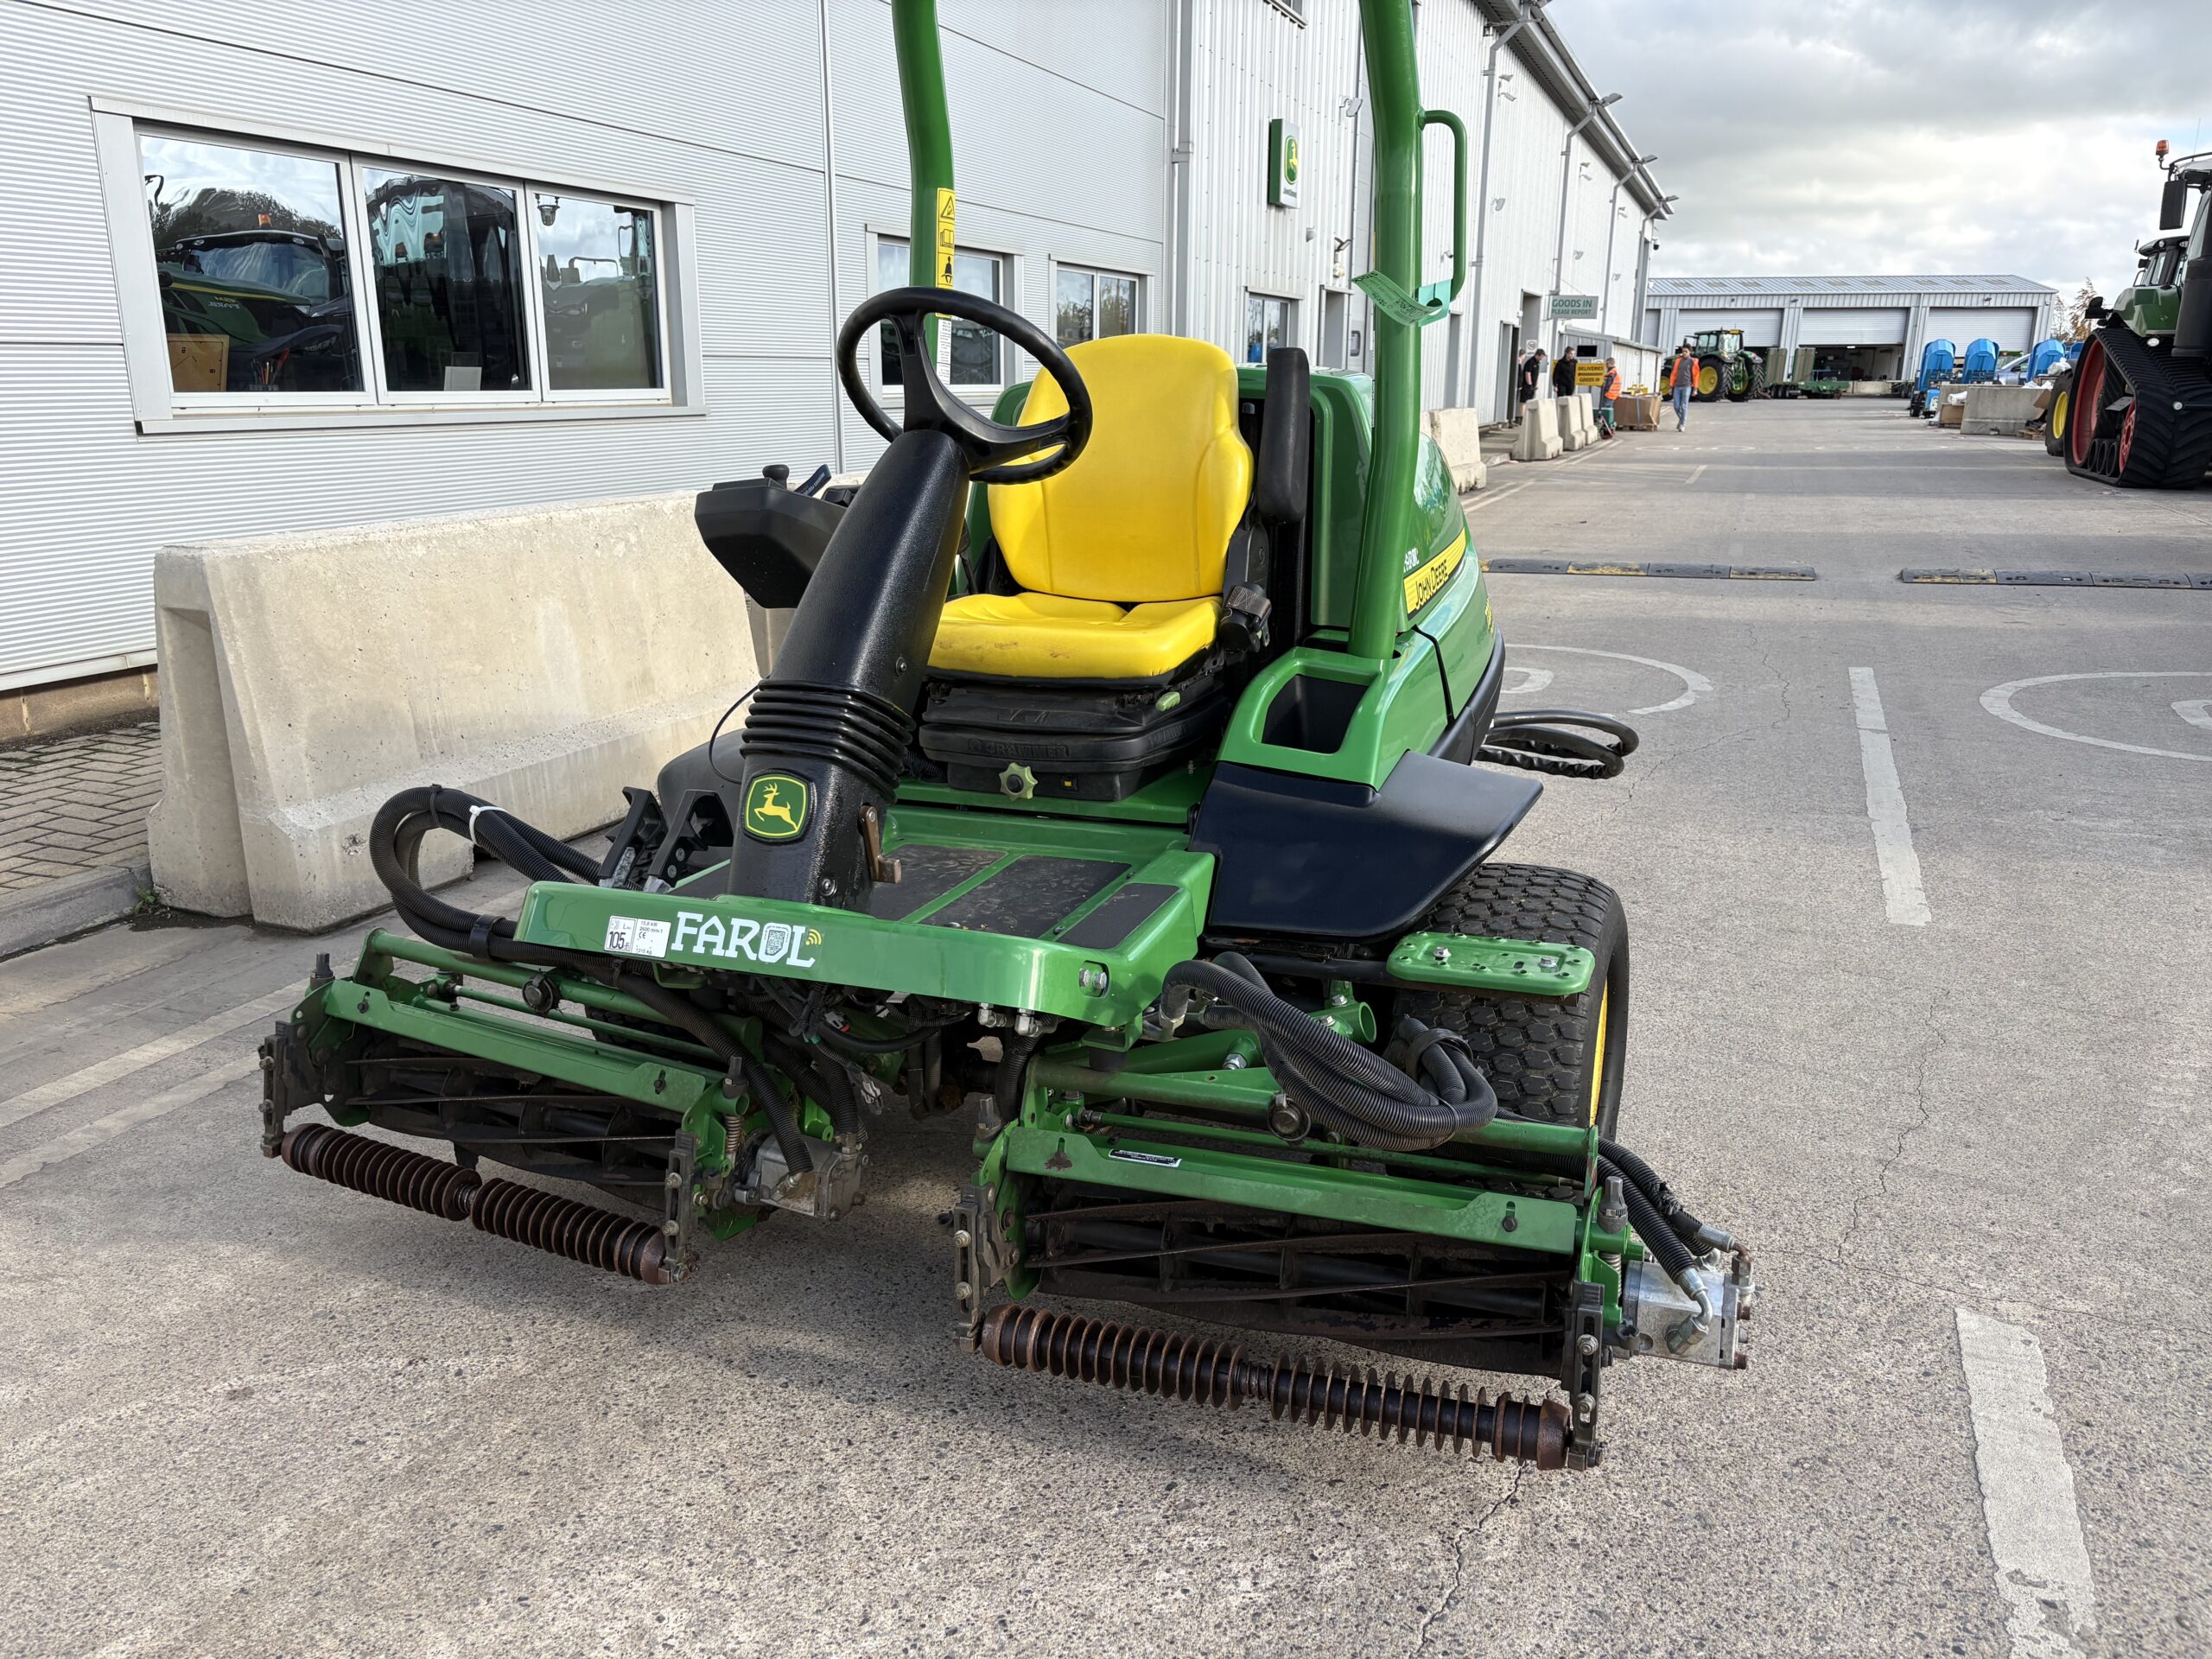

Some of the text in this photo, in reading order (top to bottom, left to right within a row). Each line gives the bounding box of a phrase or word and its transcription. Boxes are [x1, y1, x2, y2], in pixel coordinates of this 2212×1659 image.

[1552, 299, 1592, 308] GOODS IN
[609, 931, 626, 950] 105
[671, 911, 817, 968] FAROL
